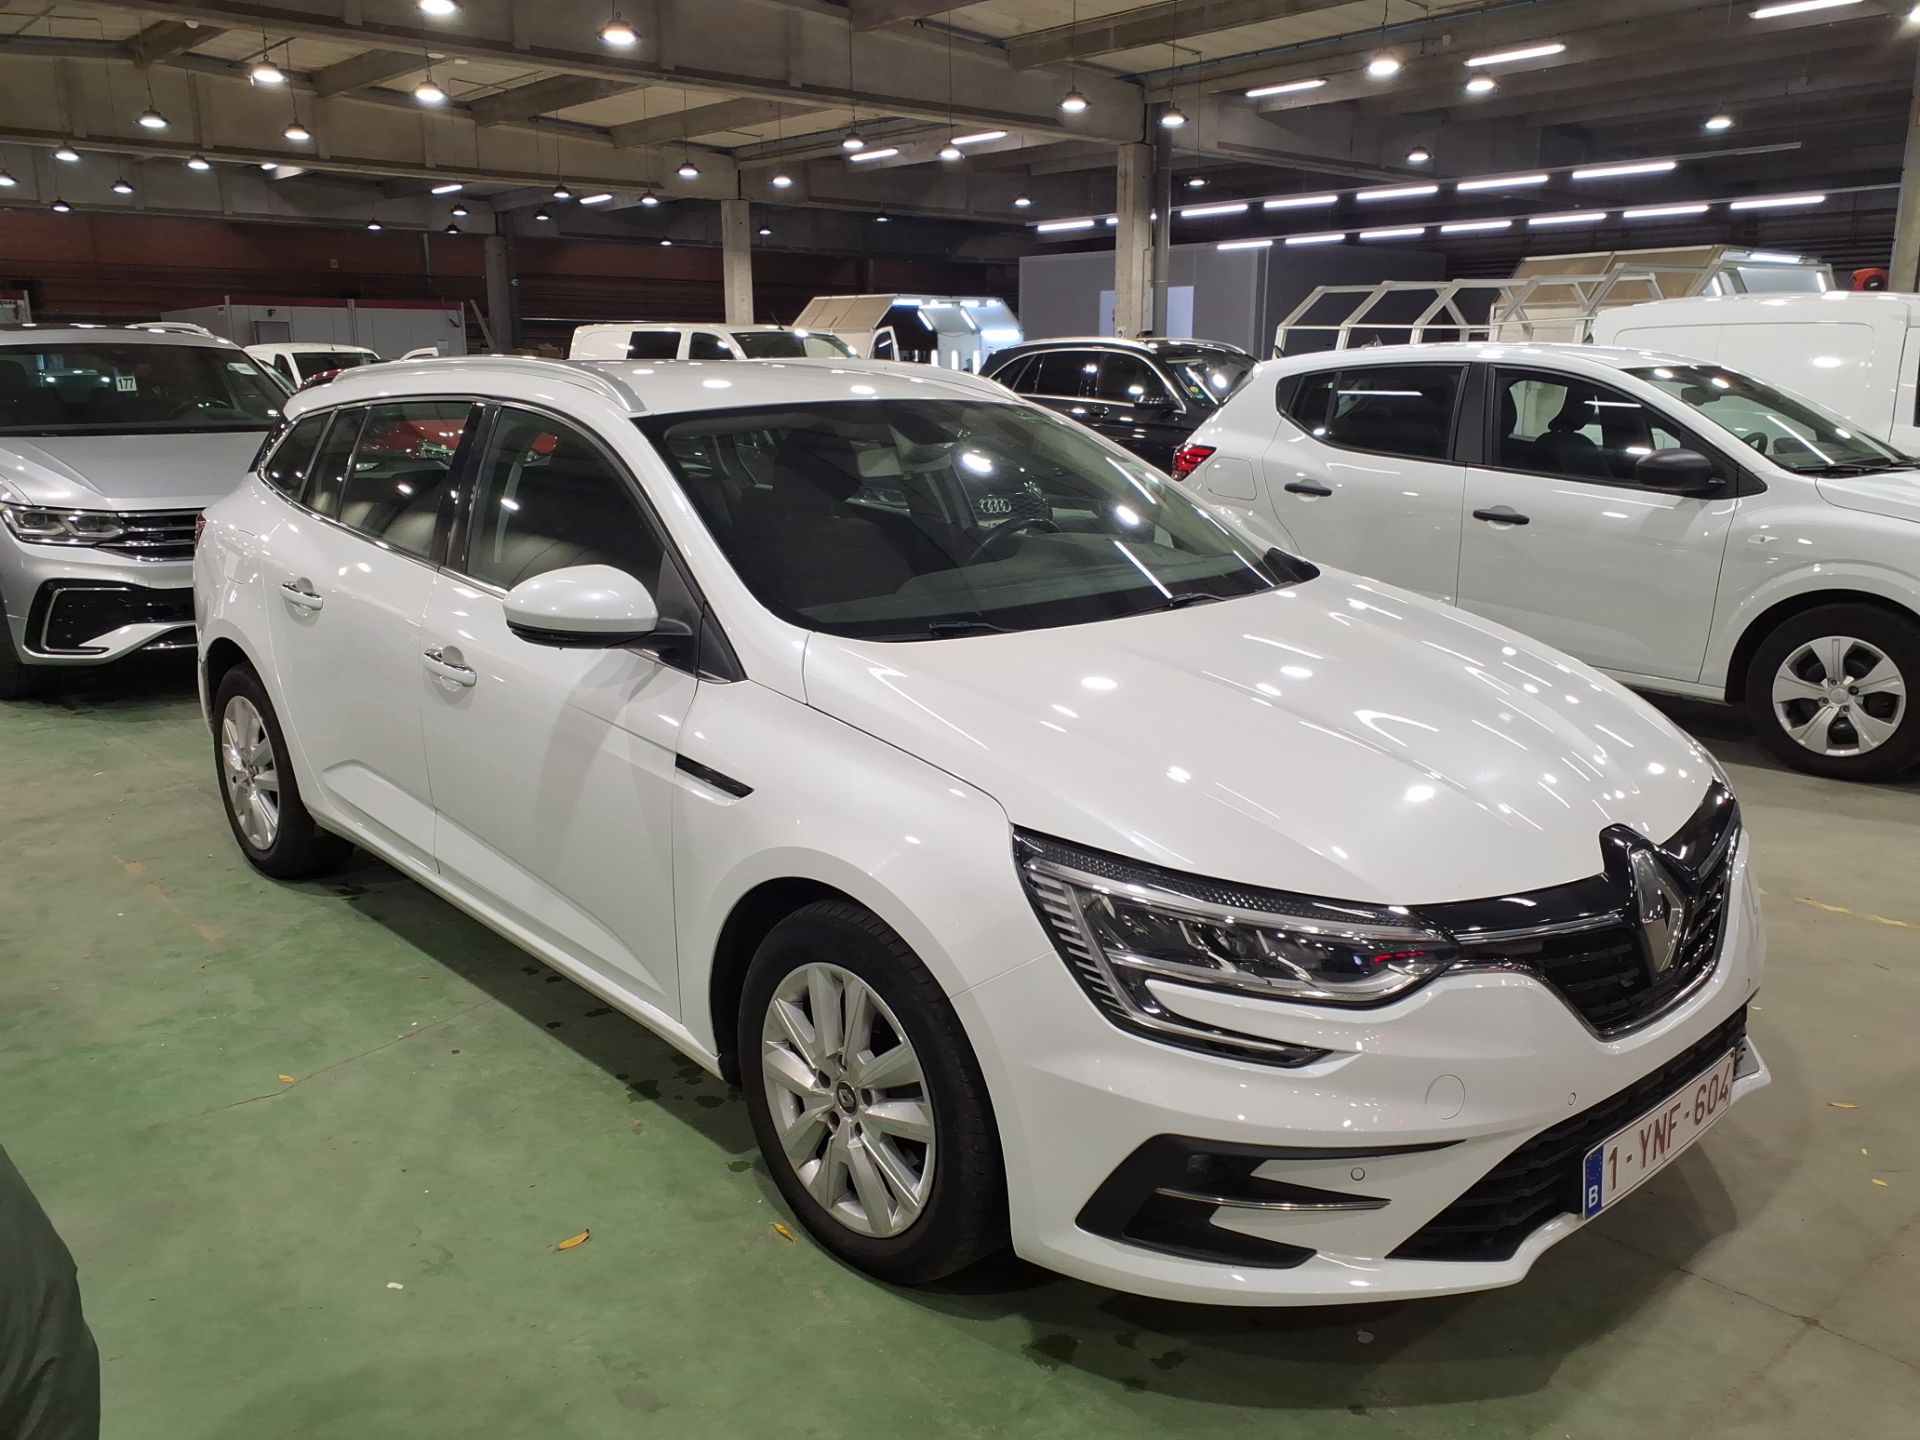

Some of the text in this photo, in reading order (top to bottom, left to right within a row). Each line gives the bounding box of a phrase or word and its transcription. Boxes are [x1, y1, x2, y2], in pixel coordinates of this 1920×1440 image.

[118, 377, 134, 390] 177
[1608, 1062, 1731, 1191] 1-YNF-604
[1588, 1184, 1599, 1209] B
